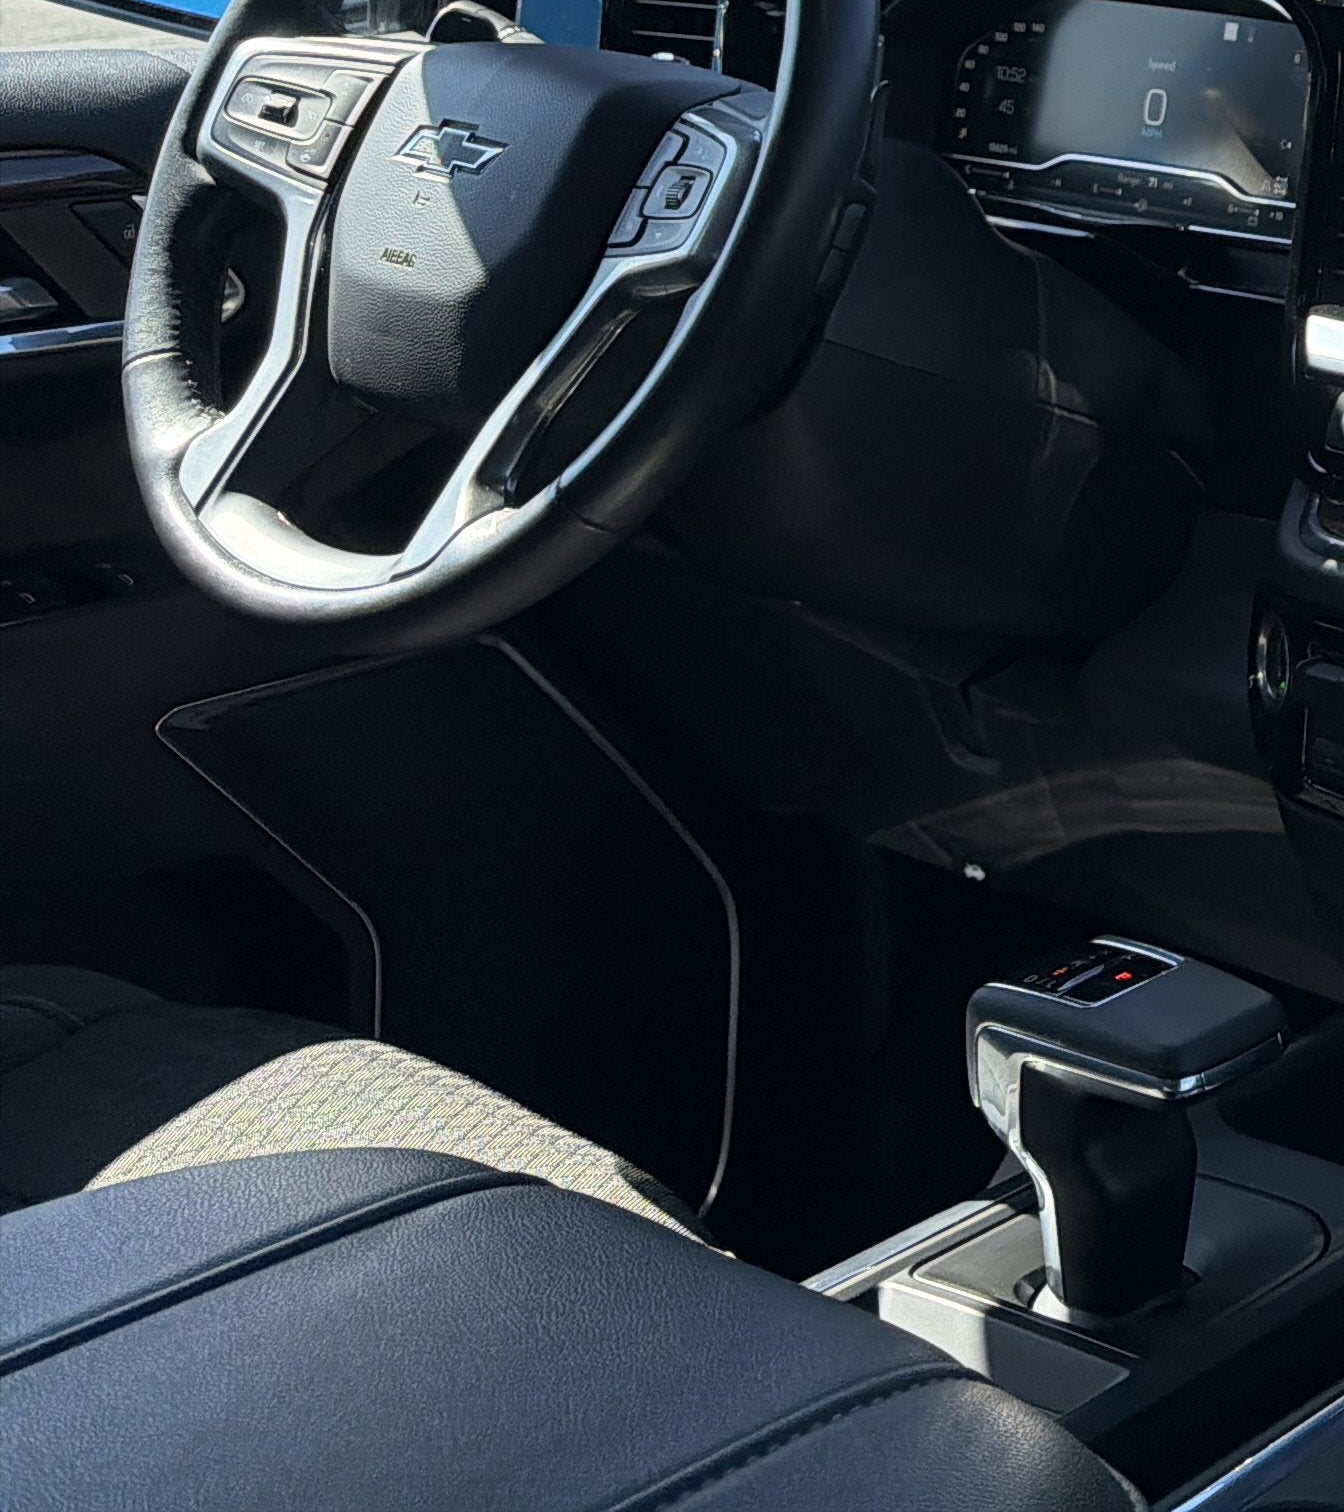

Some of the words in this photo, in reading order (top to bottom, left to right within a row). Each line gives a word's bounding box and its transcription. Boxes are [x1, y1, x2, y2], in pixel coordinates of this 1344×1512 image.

[1147, 58, 1176, 73] Speed
[1144, 88, 1167, 127] 0
[1141, 127, 1163, 139] MPH
